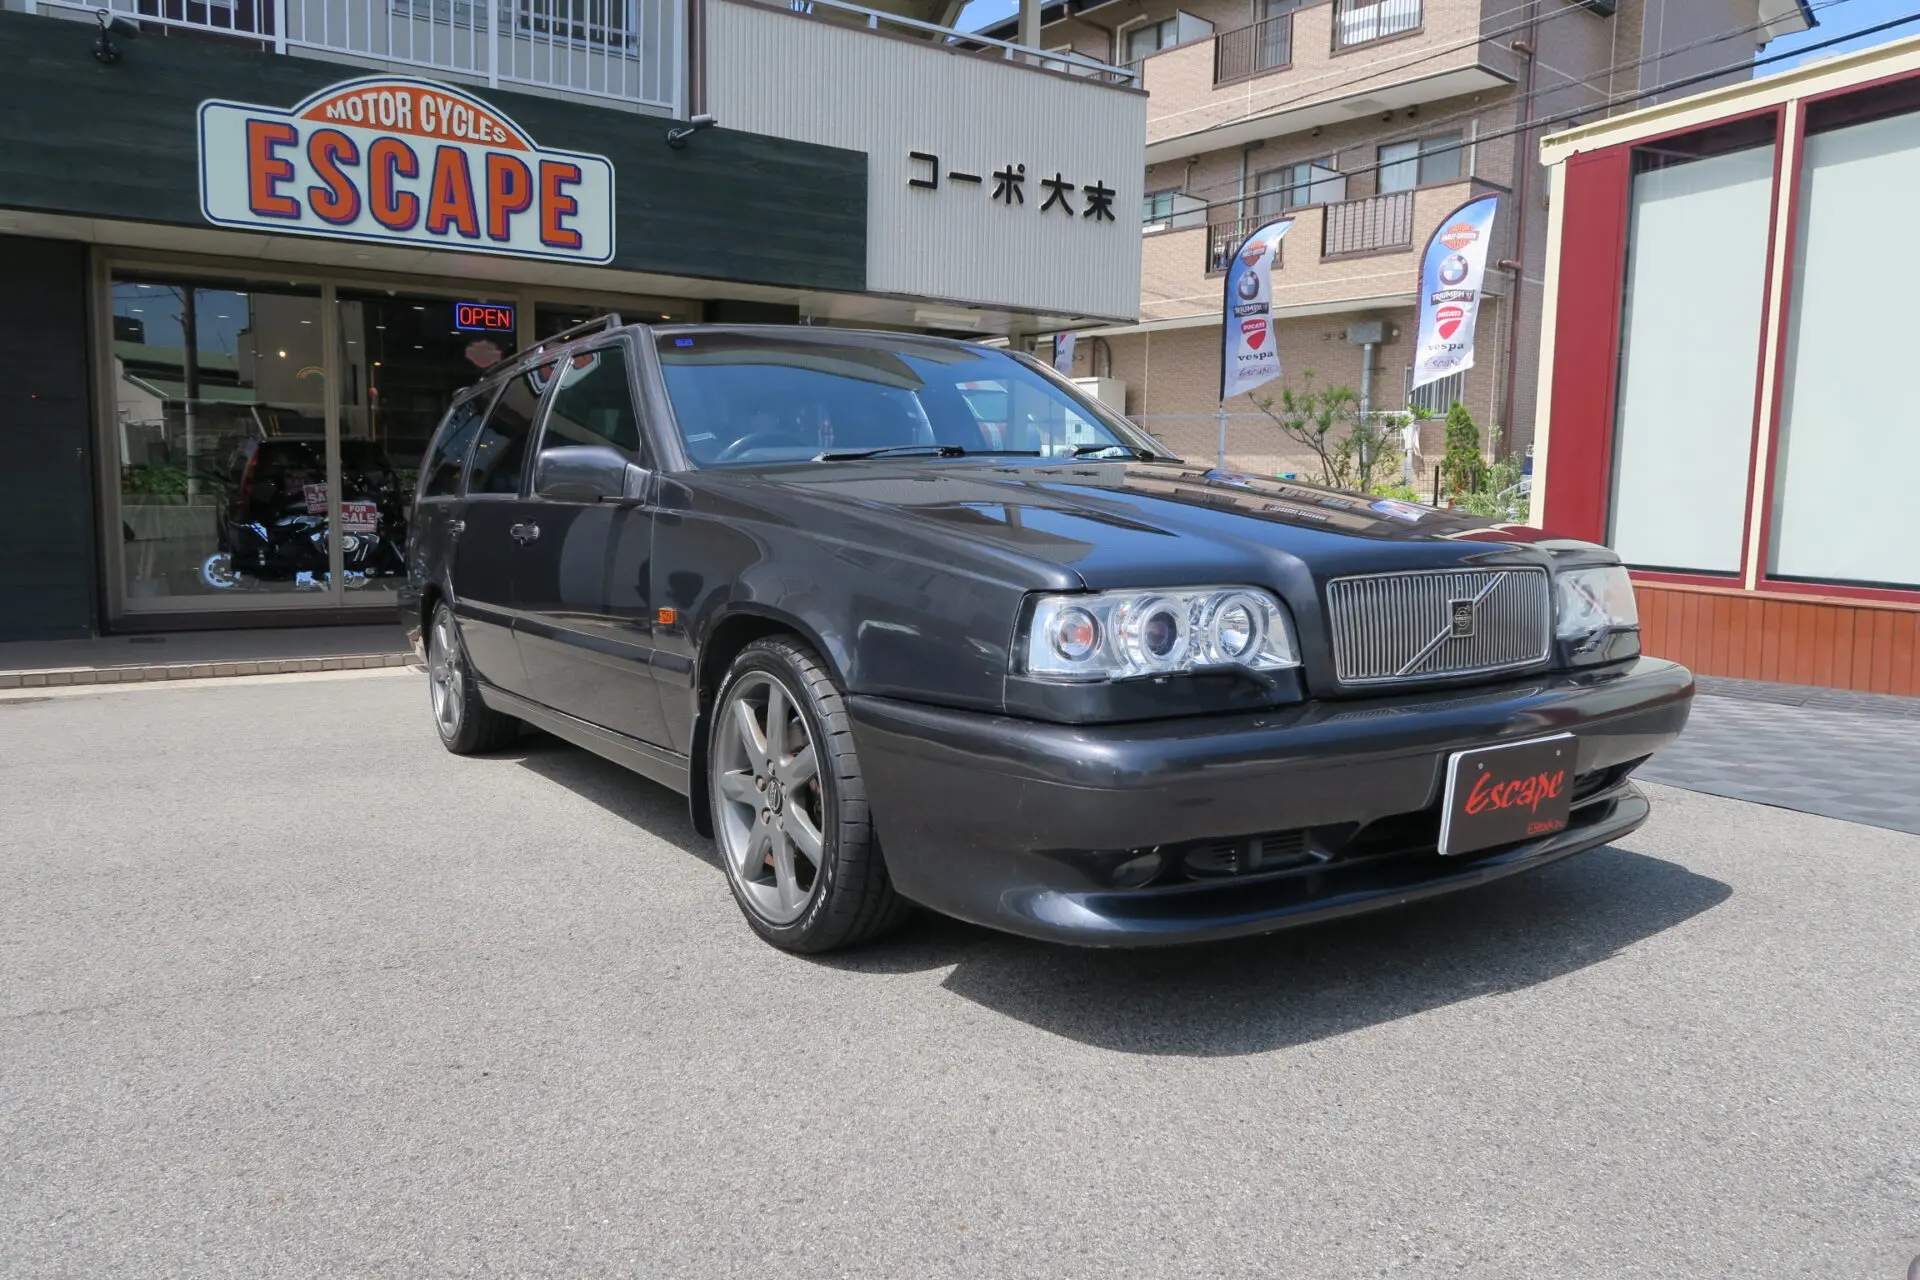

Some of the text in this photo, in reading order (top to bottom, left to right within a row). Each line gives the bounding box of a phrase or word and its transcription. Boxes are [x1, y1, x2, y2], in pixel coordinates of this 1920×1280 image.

[326, 90, 508, 143] MOTOR CYCLES
[245, 117, 582, 250] ESCAPE
[460, 306, 510, 328] OPEN
[1243, 322, 1265, 331] DUCATI
[1238, 351, 1274, 361] vespa
[308, 493, 328, 504] SA
[349, 505, 367, 513] FOR
[341, 512, 375, 525] SALE
[1464, 768, 1564, 816] Escape
